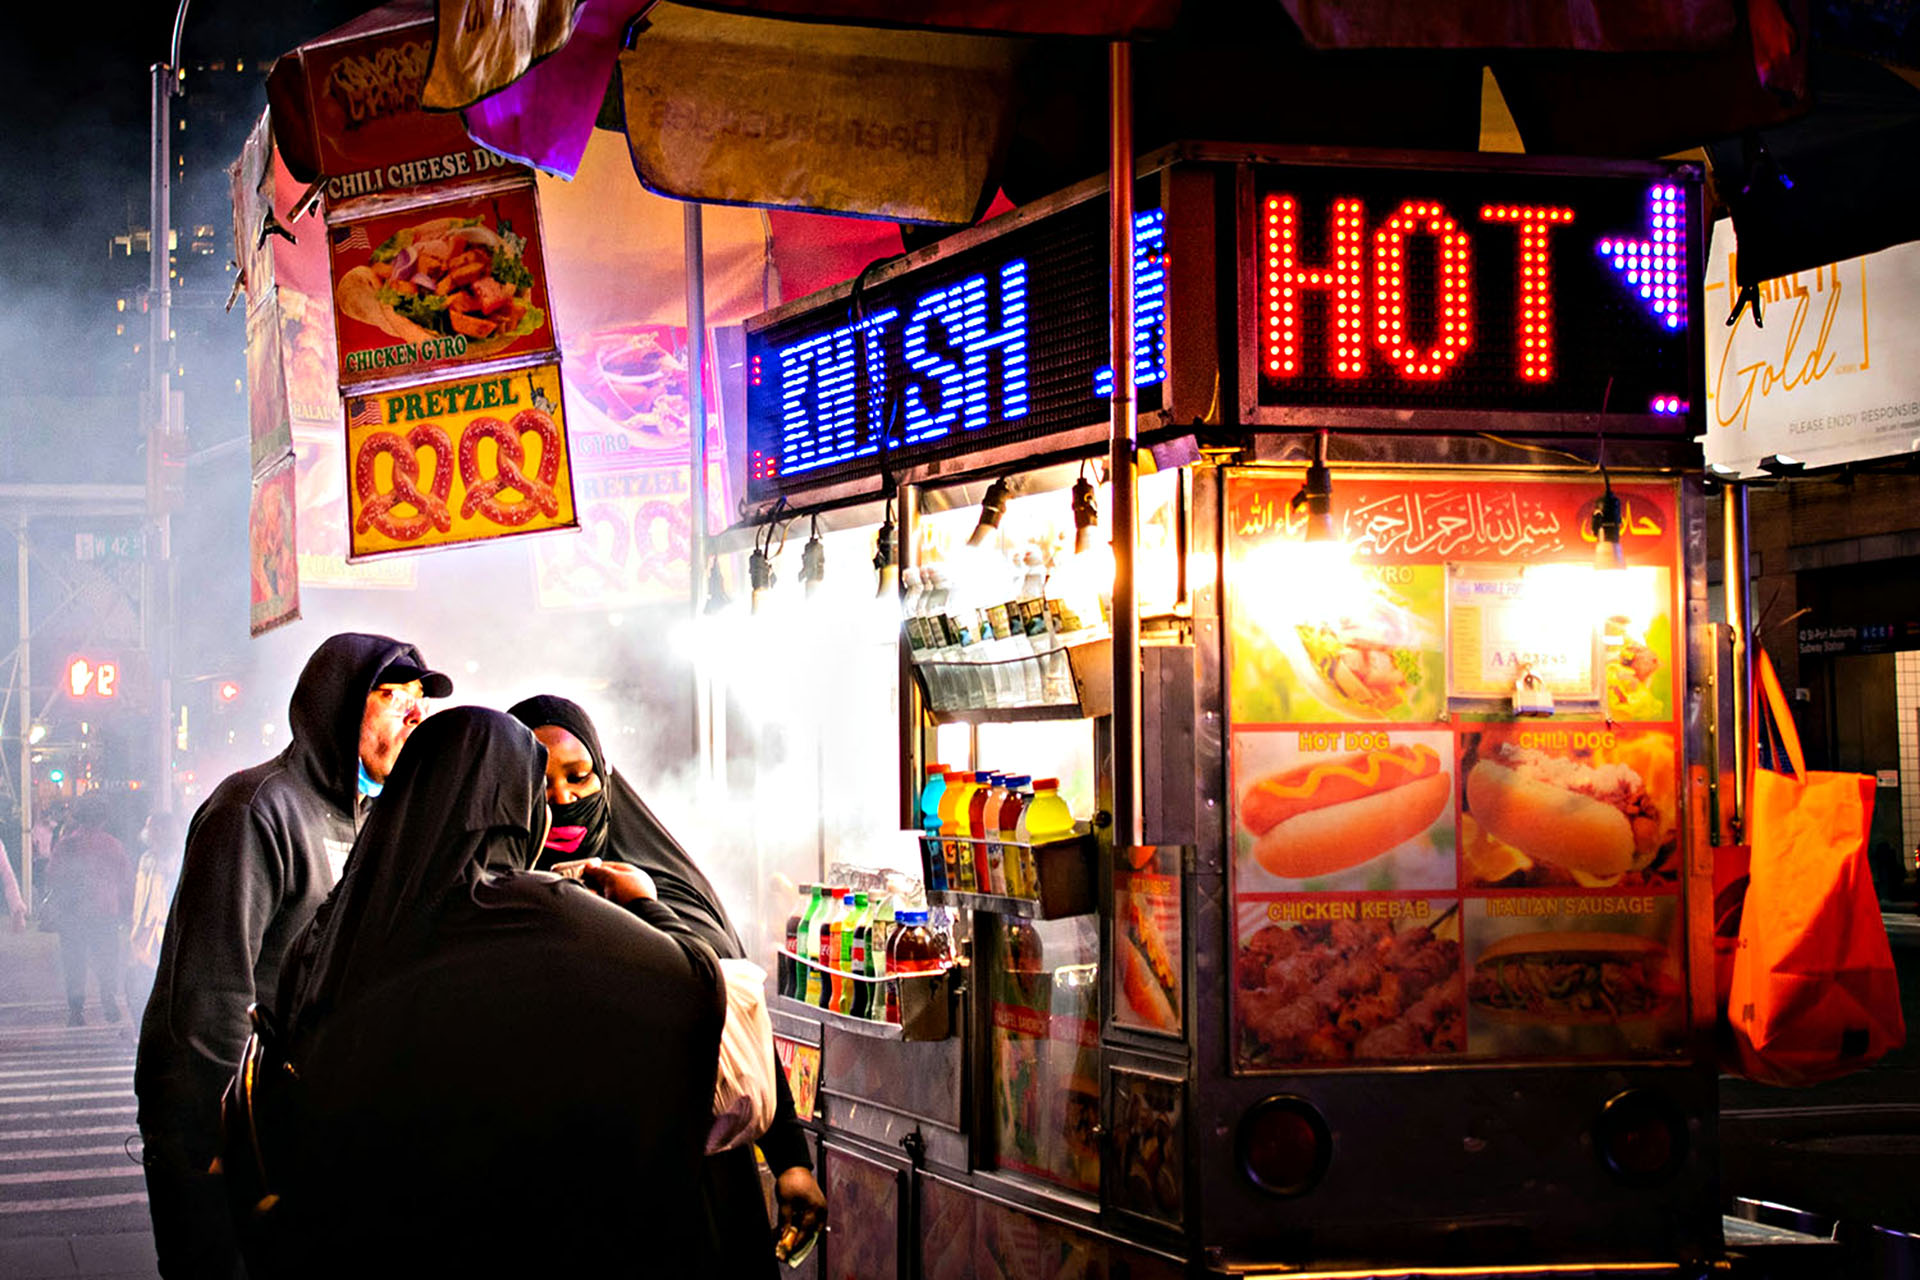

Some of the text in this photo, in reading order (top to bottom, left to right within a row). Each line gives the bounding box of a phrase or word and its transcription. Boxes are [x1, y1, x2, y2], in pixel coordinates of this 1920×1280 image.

[328, 168, 384, 200] CHILI
[387, 151, 471, 189] CHEESE
[1263, 196, 1576, 381] HOT
[345, 334, 467, 373] CHICKEN GYRO
[1716, 283, 1841, 432] Gold
[387, 377, 519, 424] PRETZEL
[1789, 417, 1825, 435] PLEASE
[1827, 413, 1857, 430] ENJOY
[580, 433, 629, 455] GYRO
[576, 470, 688, 501] RETZEL
[1299, 732, 1390, 751] HOT DOG
[1519, 731, 1617, 750] CHILI DOG
[1266, 899, 1431, 922] CHICKEN KEBAB
[1485, 896, 1655, 917] ITALIAN SAUSAGE
